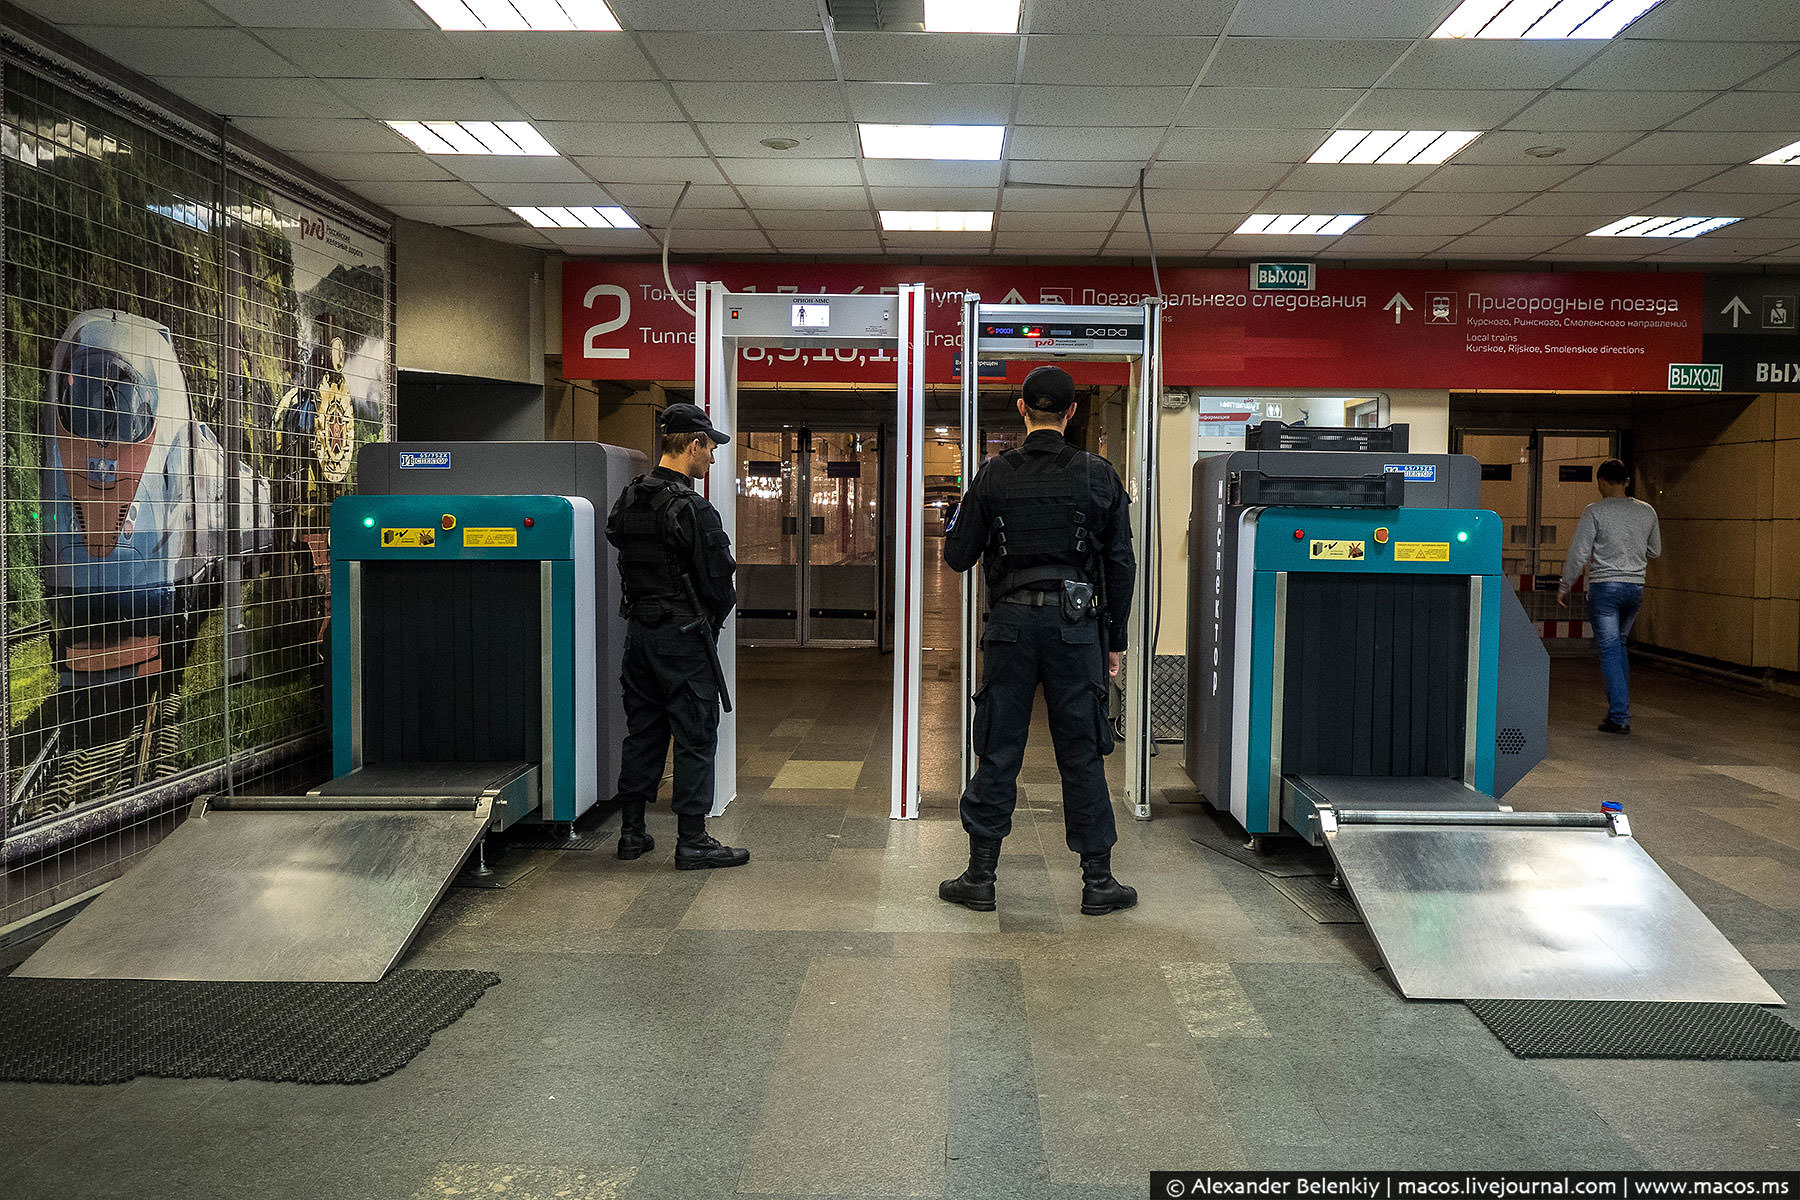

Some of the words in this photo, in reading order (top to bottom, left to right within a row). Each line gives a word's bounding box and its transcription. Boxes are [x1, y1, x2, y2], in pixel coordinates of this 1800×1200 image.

[1259, 270, 1307, 286] ВЫХОД
[640, 284, 696, 301] Тонне
[1161, 293, 1247, 310] дальнего
[1252, 294, 1367, 311] следования
[1468, 292, 1605, 315] Пригородные
[1610, 298, 1679, 316] поезда
[583, 284, 631, 359] 2
[1466, 317, 1512, 327] Курского,
[1513, 317, 1562, 328] Рижского,
[1563, 318, 1626, 328] Смоленского
[1627, 319, 1688, 329] направлений
[639, 327, 696, 344] Tunne
[925, 330, 963, 347] Trac
[1466, 333, 1490, 342] Local
[1491, 333, 1518, 342] trains
[1466, 344, 1506, 353] Kurskoe,
[1508, 344, 1543, 354] Rijskoe,
[1544, 344, 1599, 354] Smolenskoe
[1600, 345, 1646, 354] directions
[1671, 368, 1720, 388] ВЫХОД
